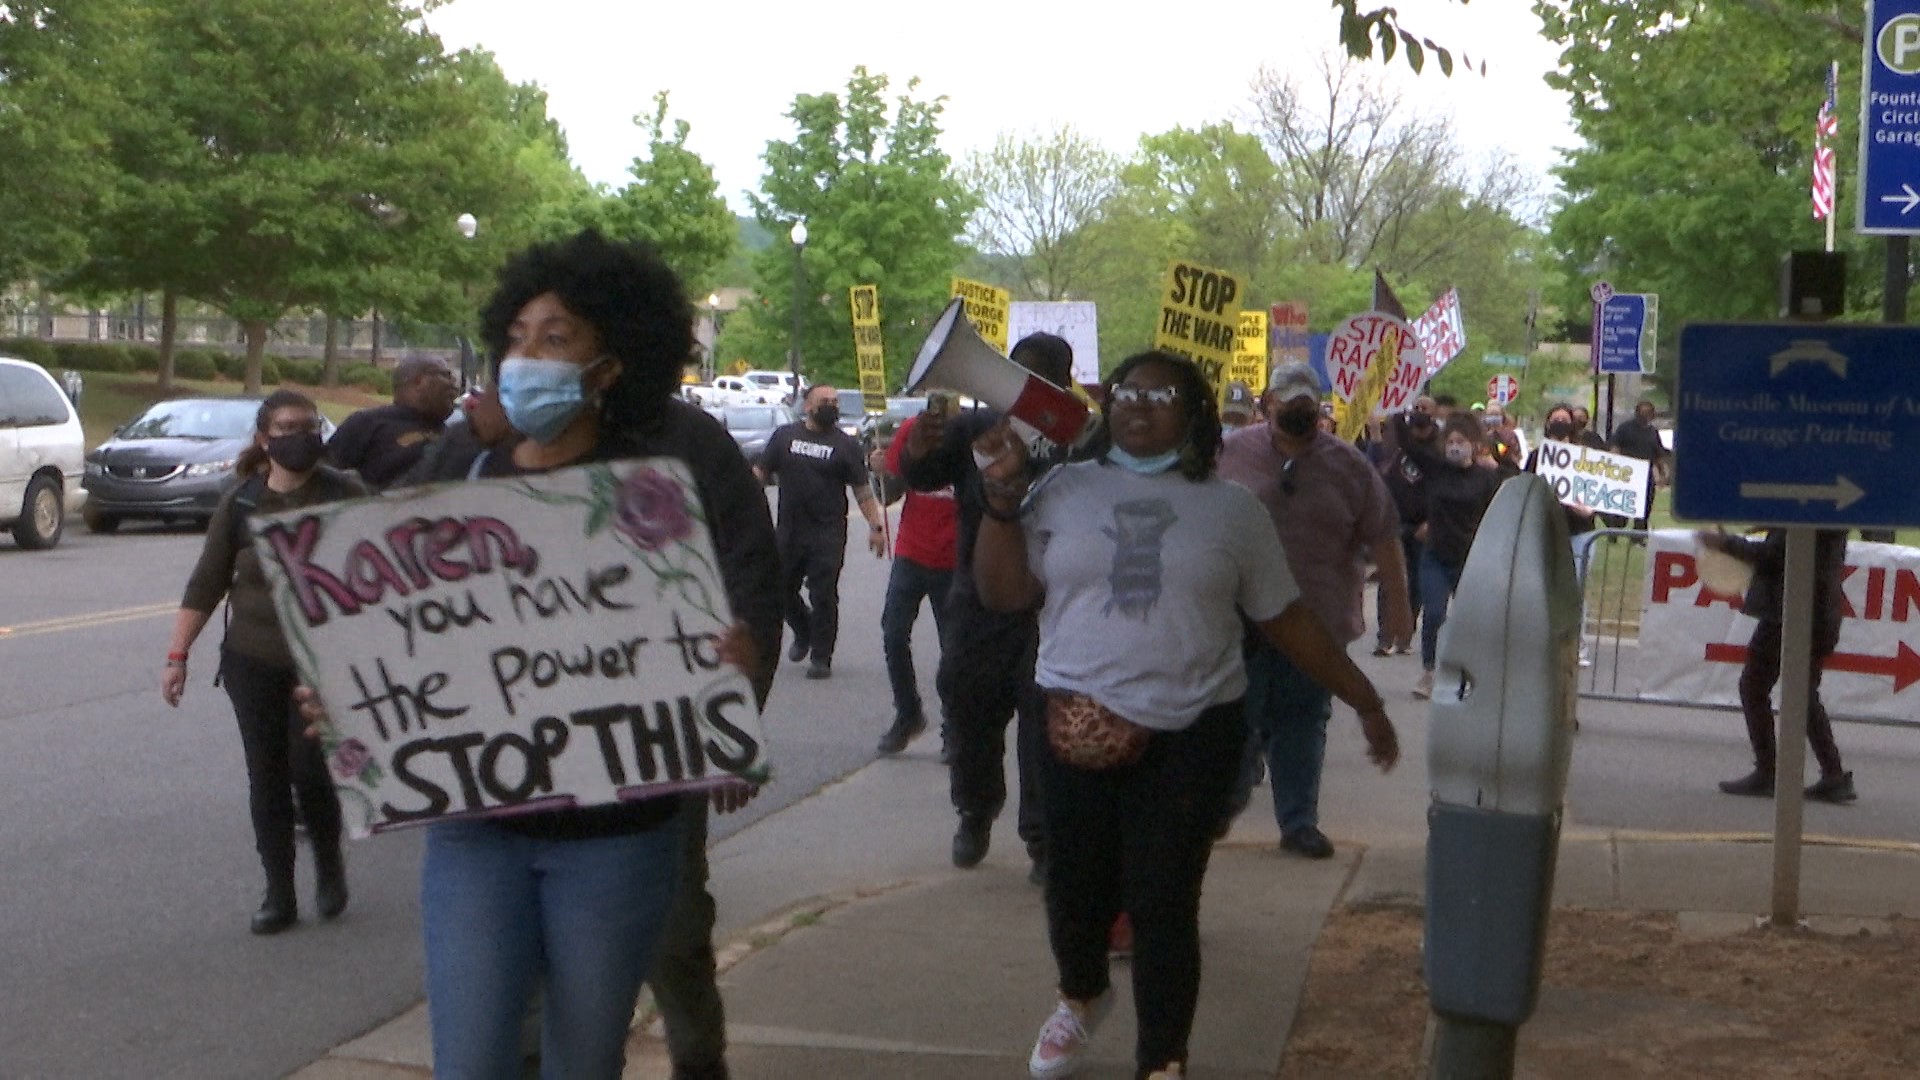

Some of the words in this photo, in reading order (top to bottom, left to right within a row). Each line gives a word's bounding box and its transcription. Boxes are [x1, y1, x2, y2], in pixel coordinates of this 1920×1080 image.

[1893, 24, 1920, 65] P
[1881, 109, 1920, 124] Circl
[955, 281, 997, 304] JUSTICE
[1171, 264, 1237, 316] STOP
[966, 301, 1004, 323] EORGE
[975, 319, 999, 335] OYD
[1162, 307, 1192, 340] THE
[1193, 317, 1234, 351] WAR
[1346, 316, 1417, 356] STOP
[1231, 365, 1259, 376] HING
[1330, 335, 1422, 392] RACSM
[1336, 367, 1408, 410] NW
[1488, 382, 1517, 394] SP
[1683, 392, 1782, 413] Huntsville
[1788, 394, 1869, 415] Museum
[1874, 396, 1899, 420] of
[790, 439, 834, 460] SECURITY
[1718, 420, 1801, 448] Garage
[1804, 422, 1895, 450] Parking
[1541, 443, 1571, 469] NO
[1572, 476, 1638, 515] PEACE
[387, 586, 493, 657] you
[506, 563, 634, 624] have
[350, 657, 471, 742] the
[665, 609, 725, 674] to
[380, 715, 570, 820] STOP
[570, 691, 761, 787] THIS
